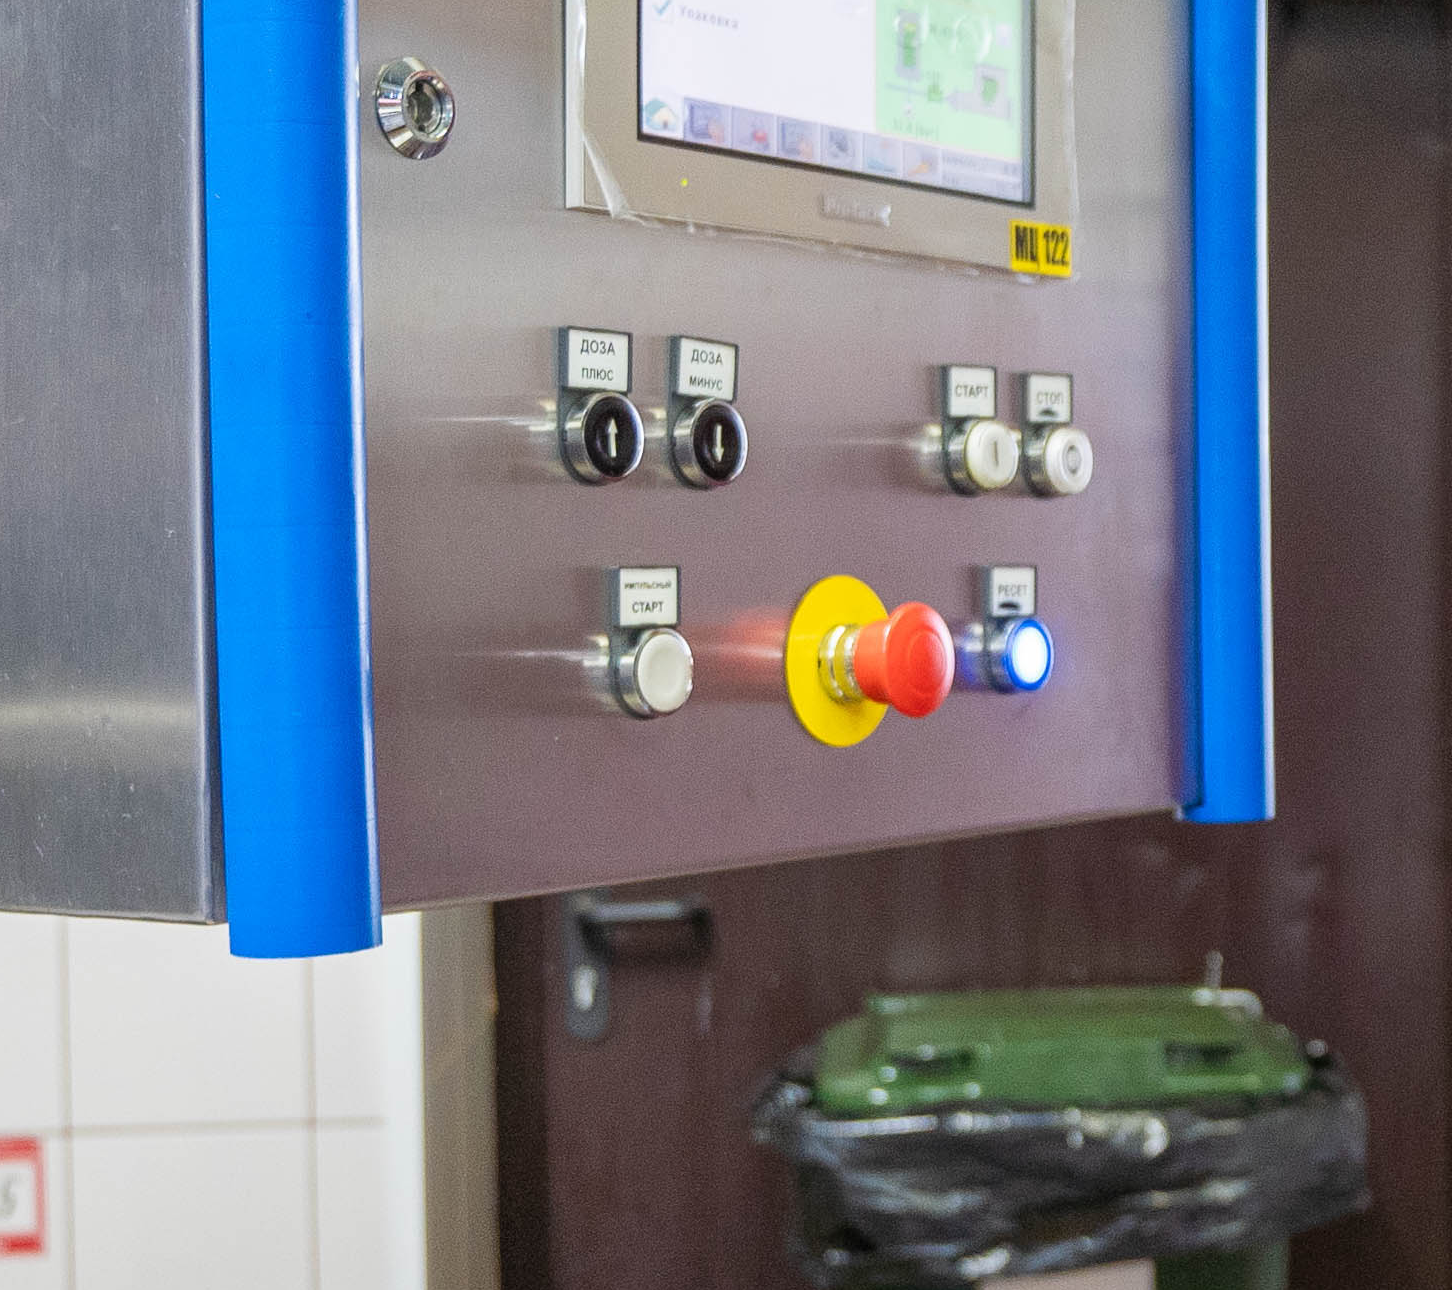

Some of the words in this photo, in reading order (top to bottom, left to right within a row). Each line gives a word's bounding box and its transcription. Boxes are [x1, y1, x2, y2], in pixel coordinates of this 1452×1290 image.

[1015, 223, 1040, 270] МЦ
[1043, 229, 1069, 267] 122
[580, 338, 615, 356] ДОЗА
[690, 348, 723, 366] ДОЗА
[581, 367, 614, 382] ПЛЮС
[689, 375, 723, 391] МИНУС
[954, 385, 989, 398] СТАРТ
[1036, 392, 1064, 406] СТОП
[631, 601, 664, 614] СТАРТ
